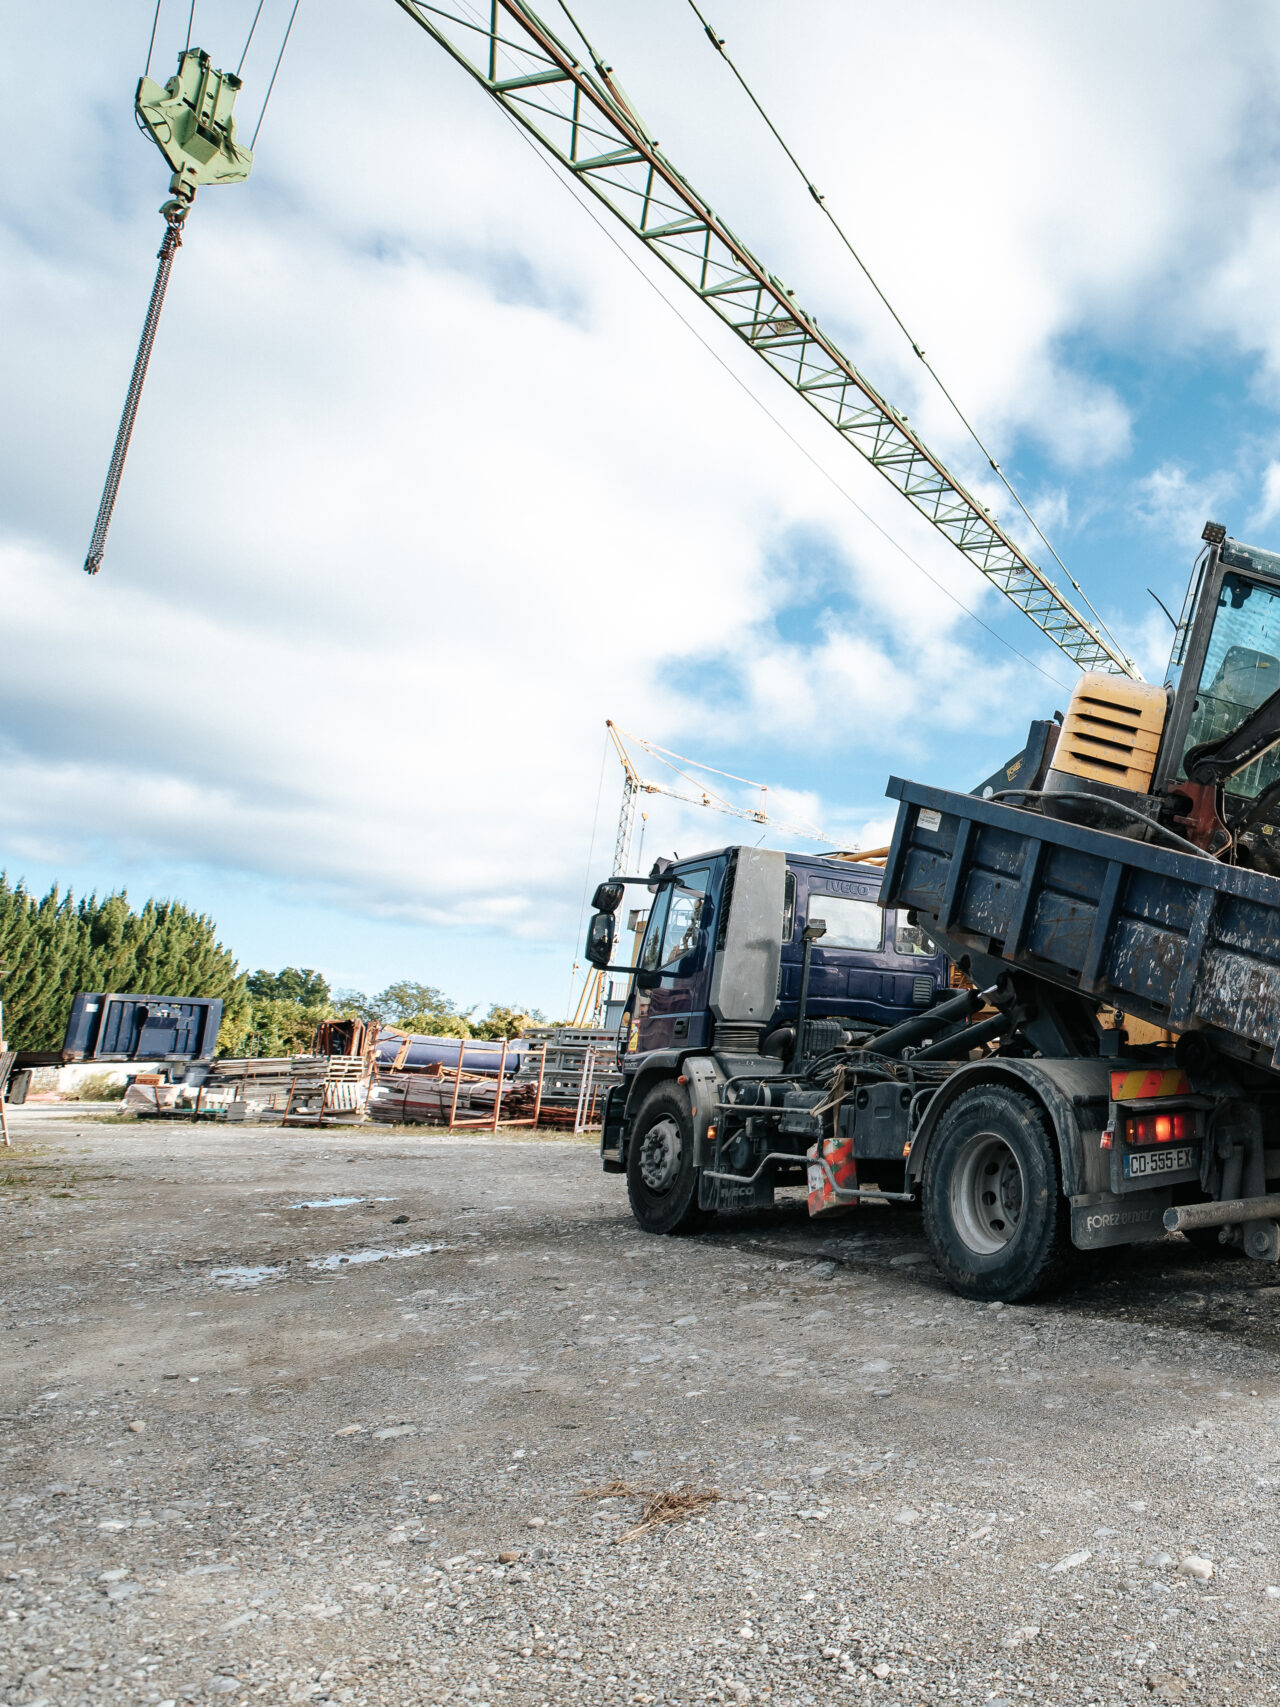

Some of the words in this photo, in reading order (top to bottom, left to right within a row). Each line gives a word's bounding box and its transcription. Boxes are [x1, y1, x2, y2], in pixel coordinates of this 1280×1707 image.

[825, 880, 869, 895] IVECO
[1130, 1149, 1191, 1175] CD-555-EX
[1087, 1213, 1120, 1231] FOREZ
